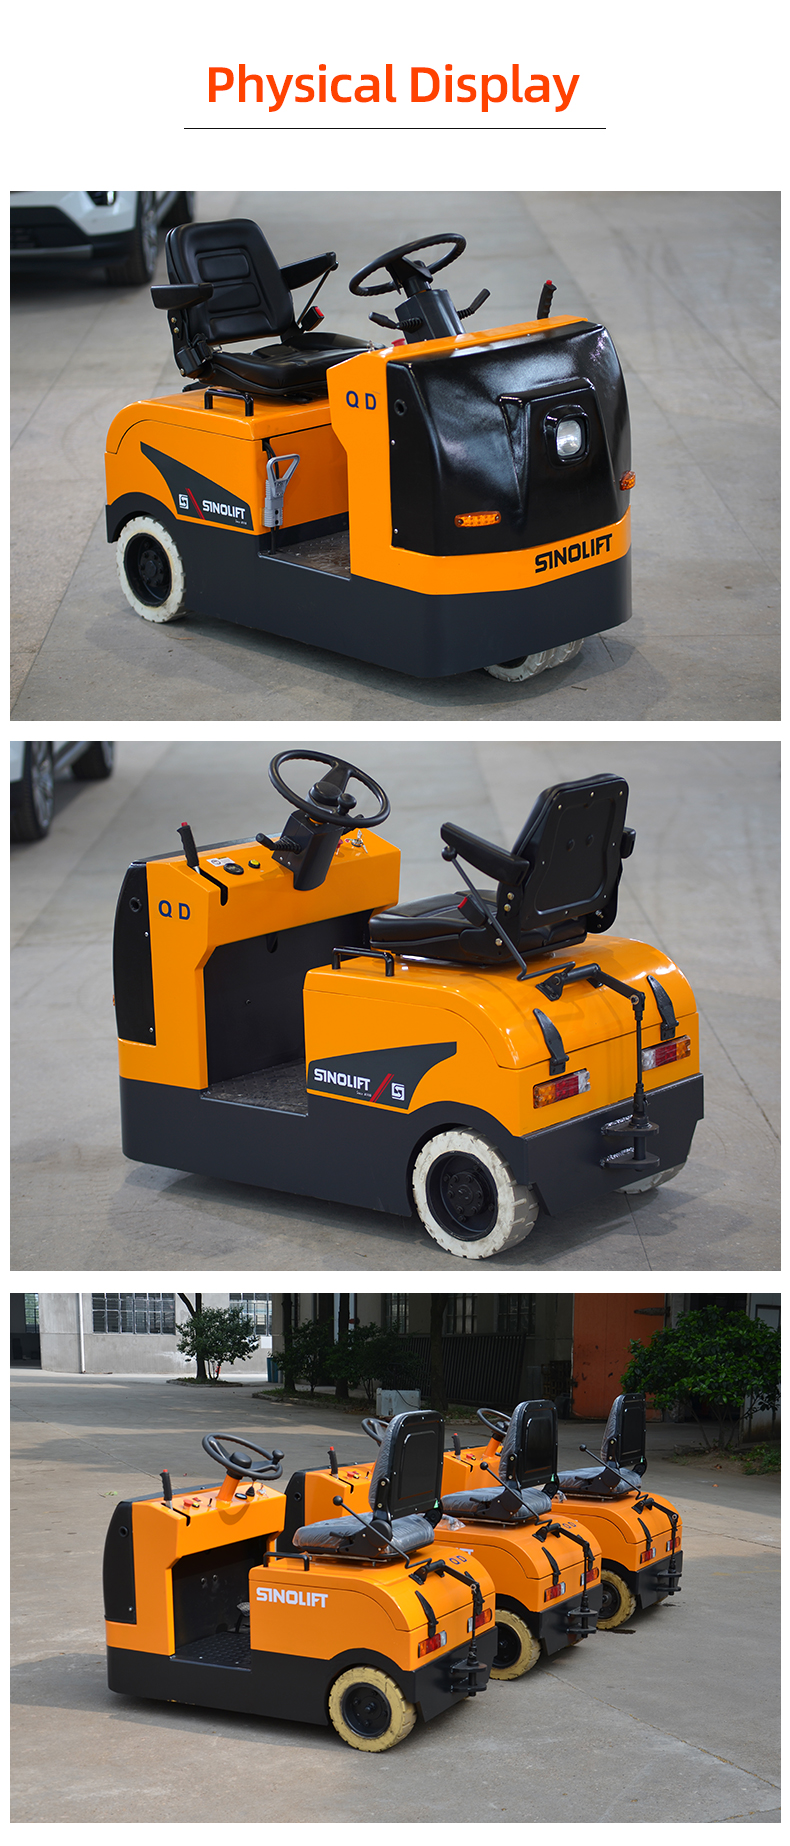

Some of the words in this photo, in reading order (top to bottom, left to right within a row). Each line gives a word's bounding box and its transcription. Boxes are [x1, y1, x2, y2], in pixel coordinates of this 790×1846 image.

[202, 499, 246, 520] SINOLIFT
[535, 533, 613, 574] SINOLIFT
[313, 1068, 371, 1091] SINOLIFT
[256, 1586, 329, 1608] SINOLIFT
